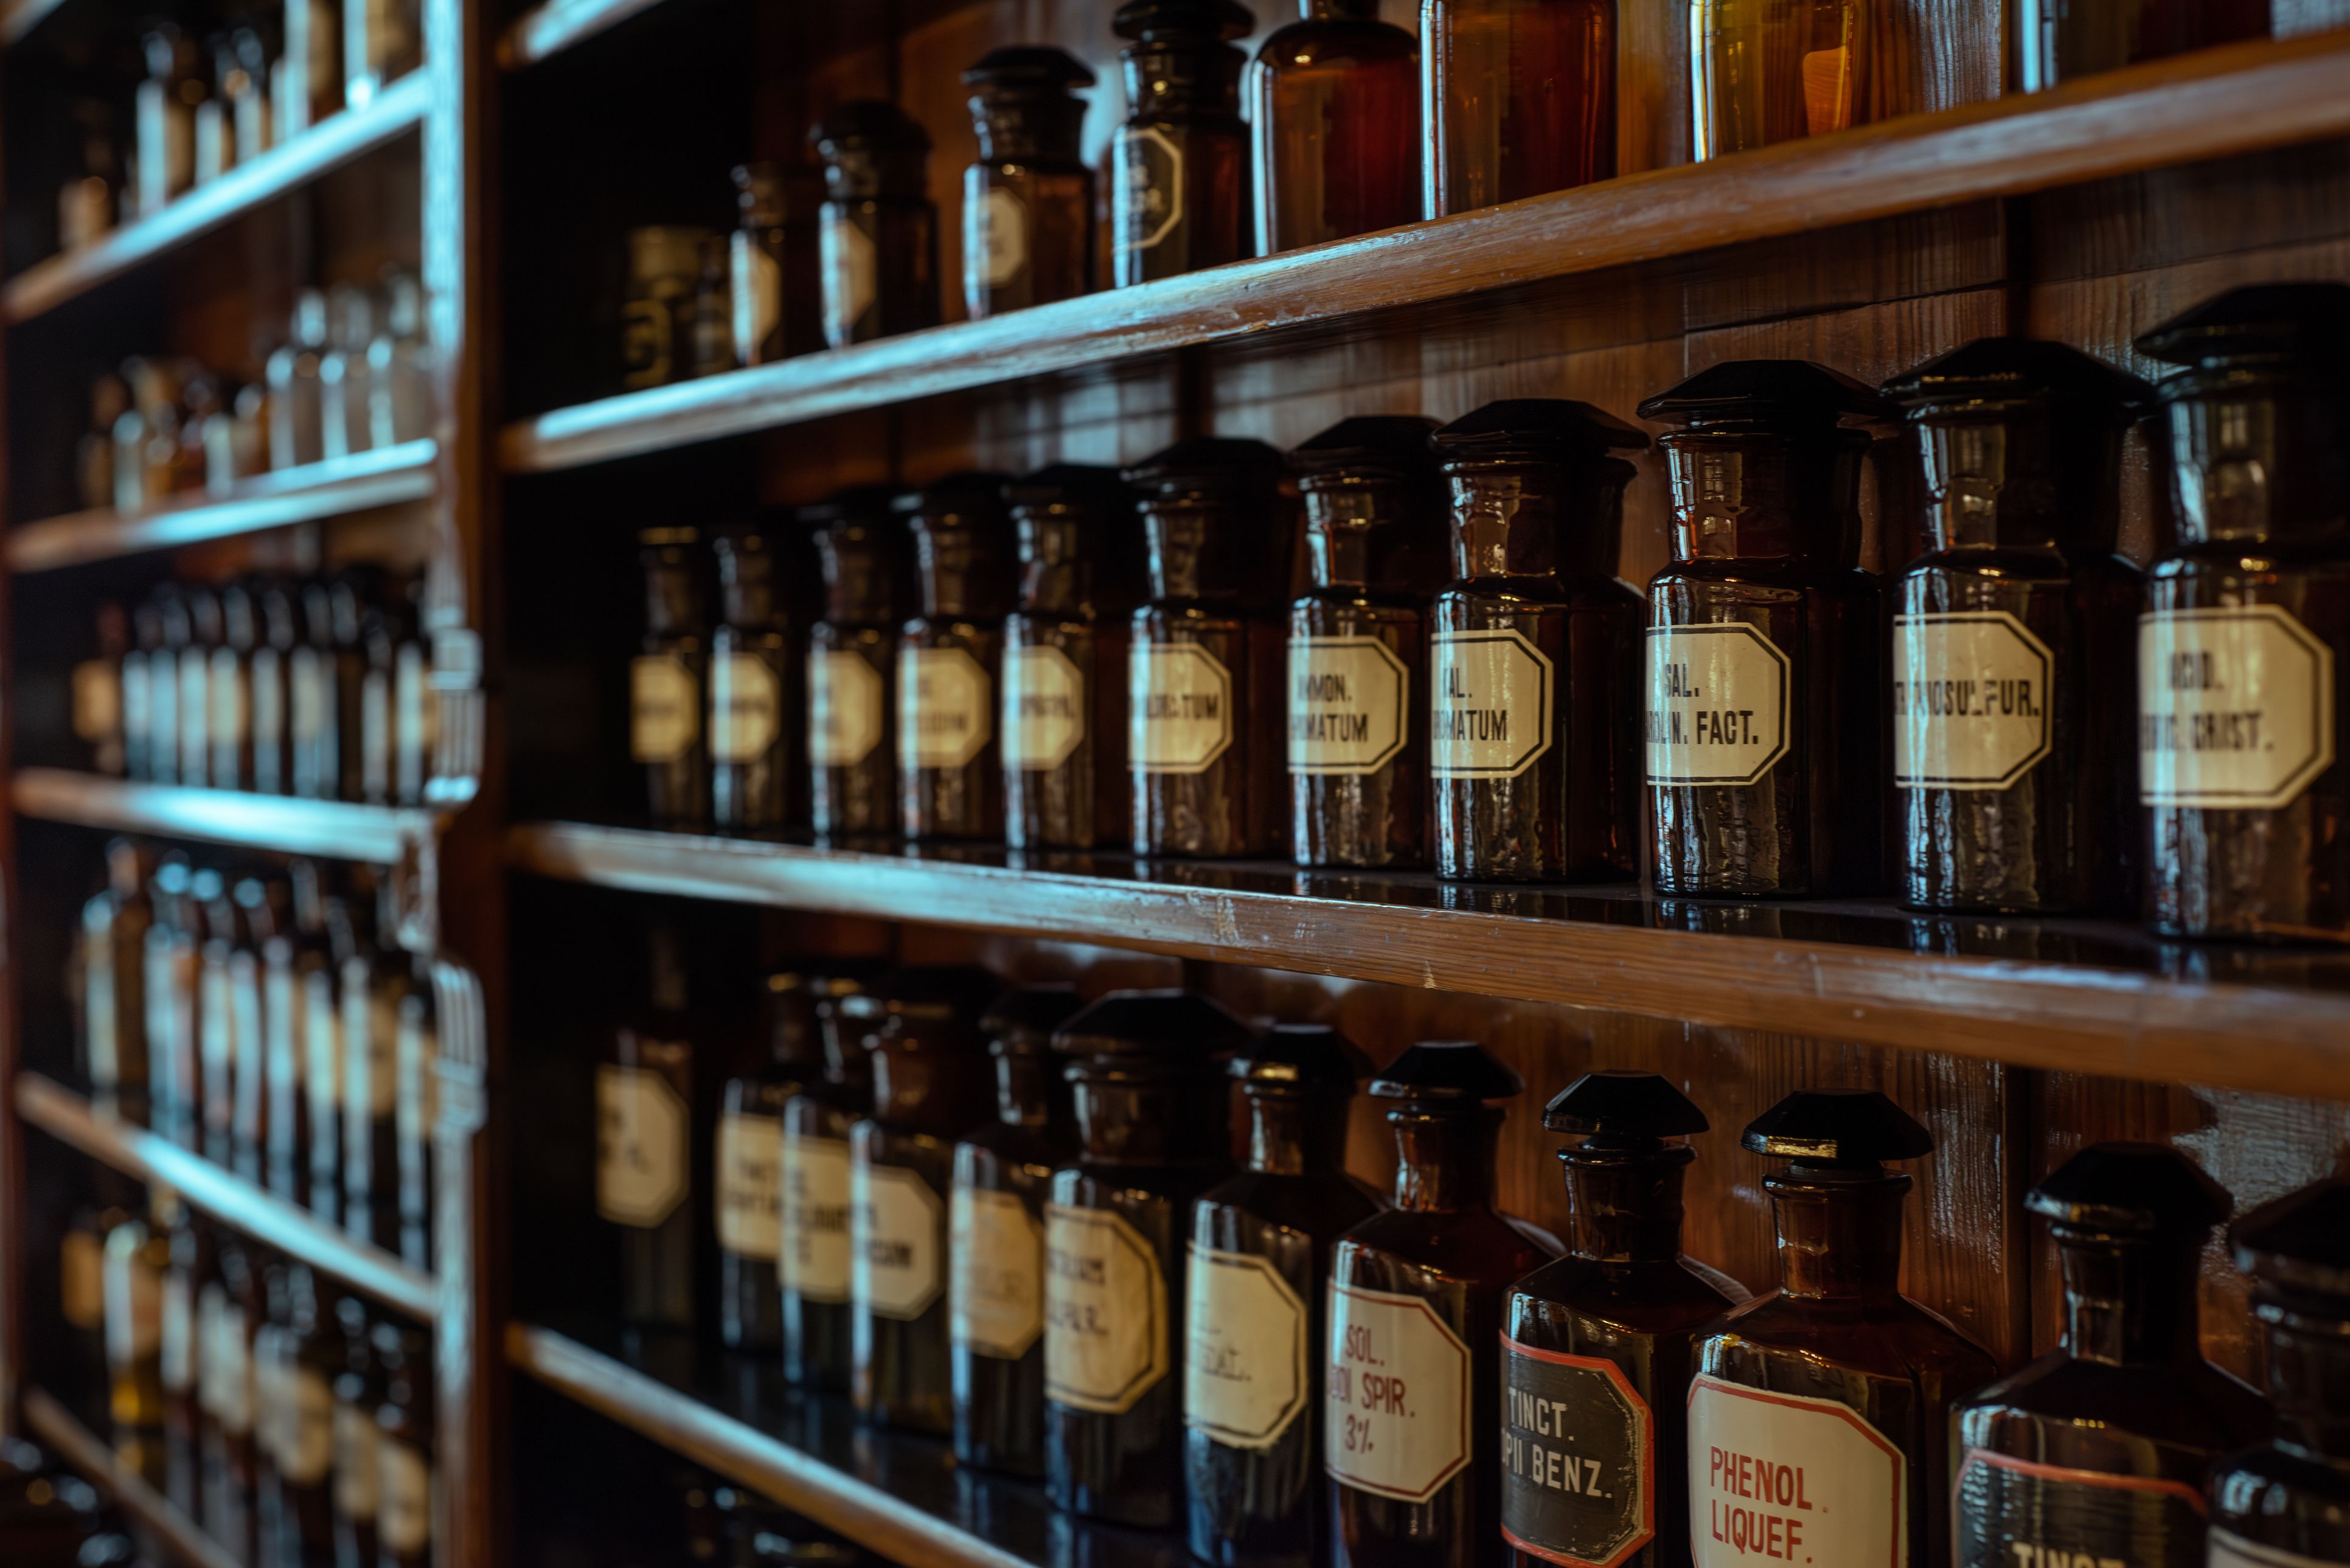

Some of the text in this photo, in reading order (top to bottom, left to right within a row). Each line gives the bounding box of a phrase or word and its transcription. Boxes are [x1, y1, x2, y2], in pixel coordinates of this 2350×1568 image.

[1664, 664, 1699, 698] SAL.
[1697, 710, 1759, 744] FACT.
[1346, 1324, 1385, 1366] SOL.
[1361, 1372, 1416, 1418] SPIR.
[1509, 1387, 1574, 1441] TINCT.
[1532, 1443, 1613, 1499] BENZ.
[1711, 1499, 1813, 1564] LIQUEF.
